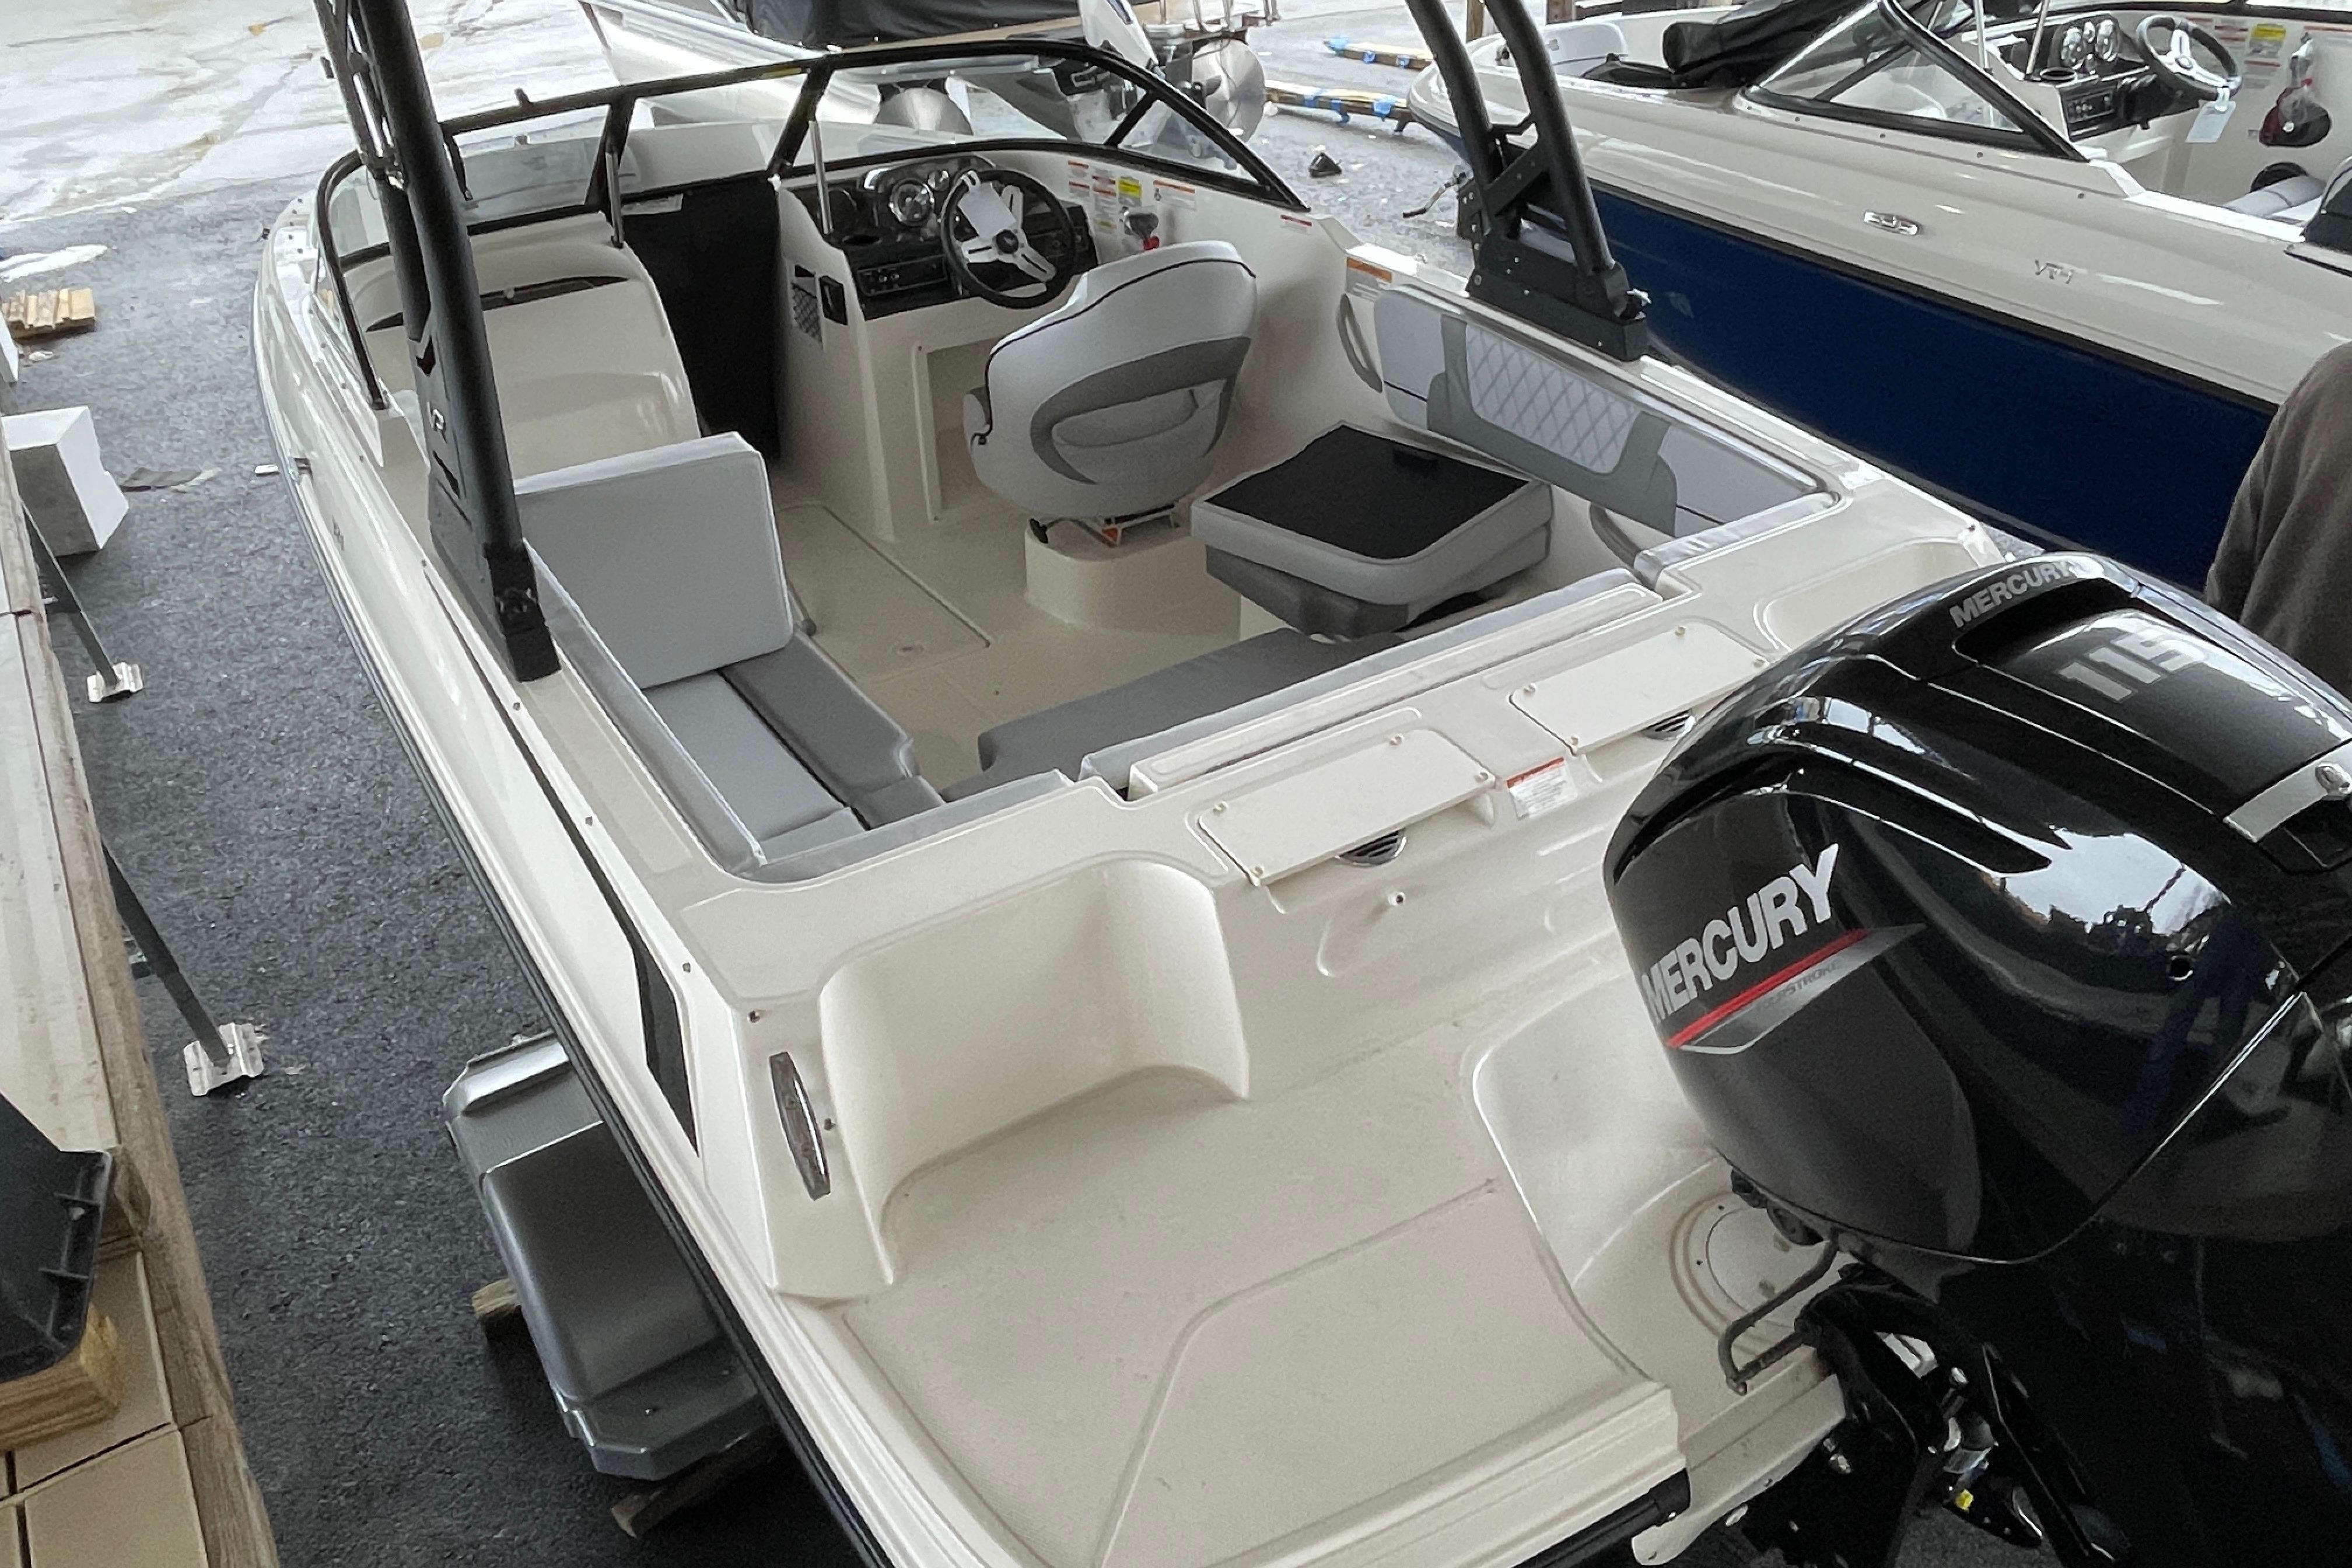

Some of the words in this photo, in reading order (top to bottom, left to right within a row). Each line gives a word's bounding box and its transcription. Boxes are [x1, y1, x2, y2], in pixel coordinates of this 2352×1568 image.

[1949, 559, 2072, 629] MERCURY
[2058, 629, 2206, 701] 115
[1641, 842, 1839, 1024] MERCURY
